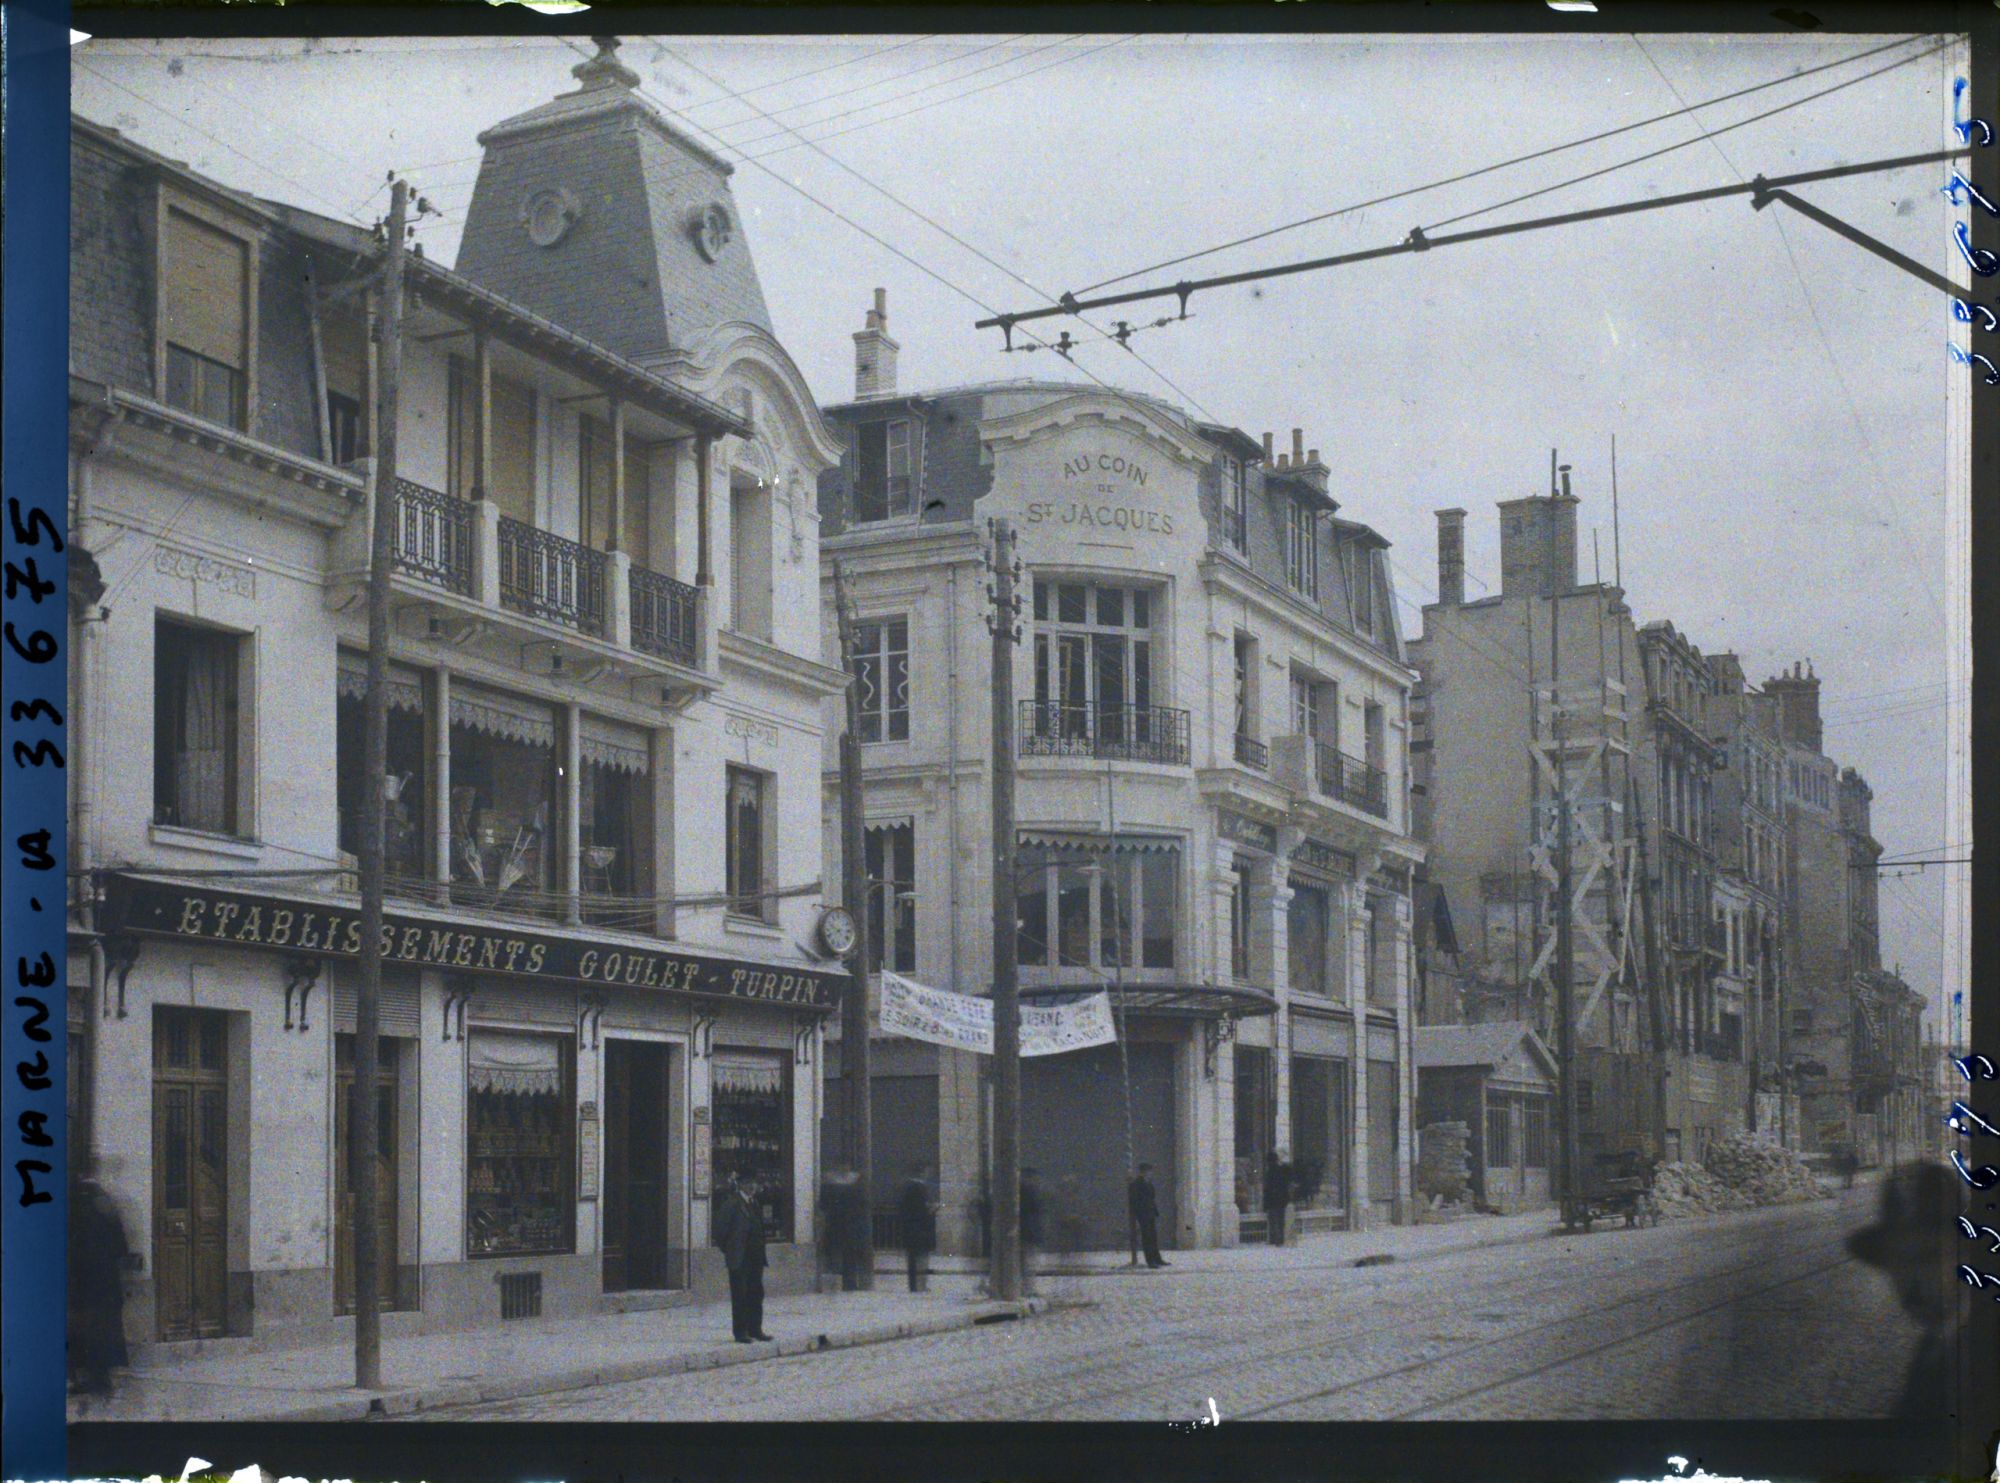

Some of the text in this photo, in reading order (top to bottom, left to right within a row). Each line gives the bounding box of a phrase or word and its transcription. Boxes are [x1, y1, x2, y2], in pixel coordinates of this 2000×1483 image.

[1063, 454, 1148, 486] AU COIN
[1097, 482, 1115, 494] DE
[1061, 503, 1174, 536] JACQUES
[16, 828, 57, 871] A
[175, 897, 548, 975] ETABLISSEMENTS
[578, 950, 700, 991] GOULET
[730, 967, 822, 1003] TURPIN
[15, 951, 56, 1208] MARNE
